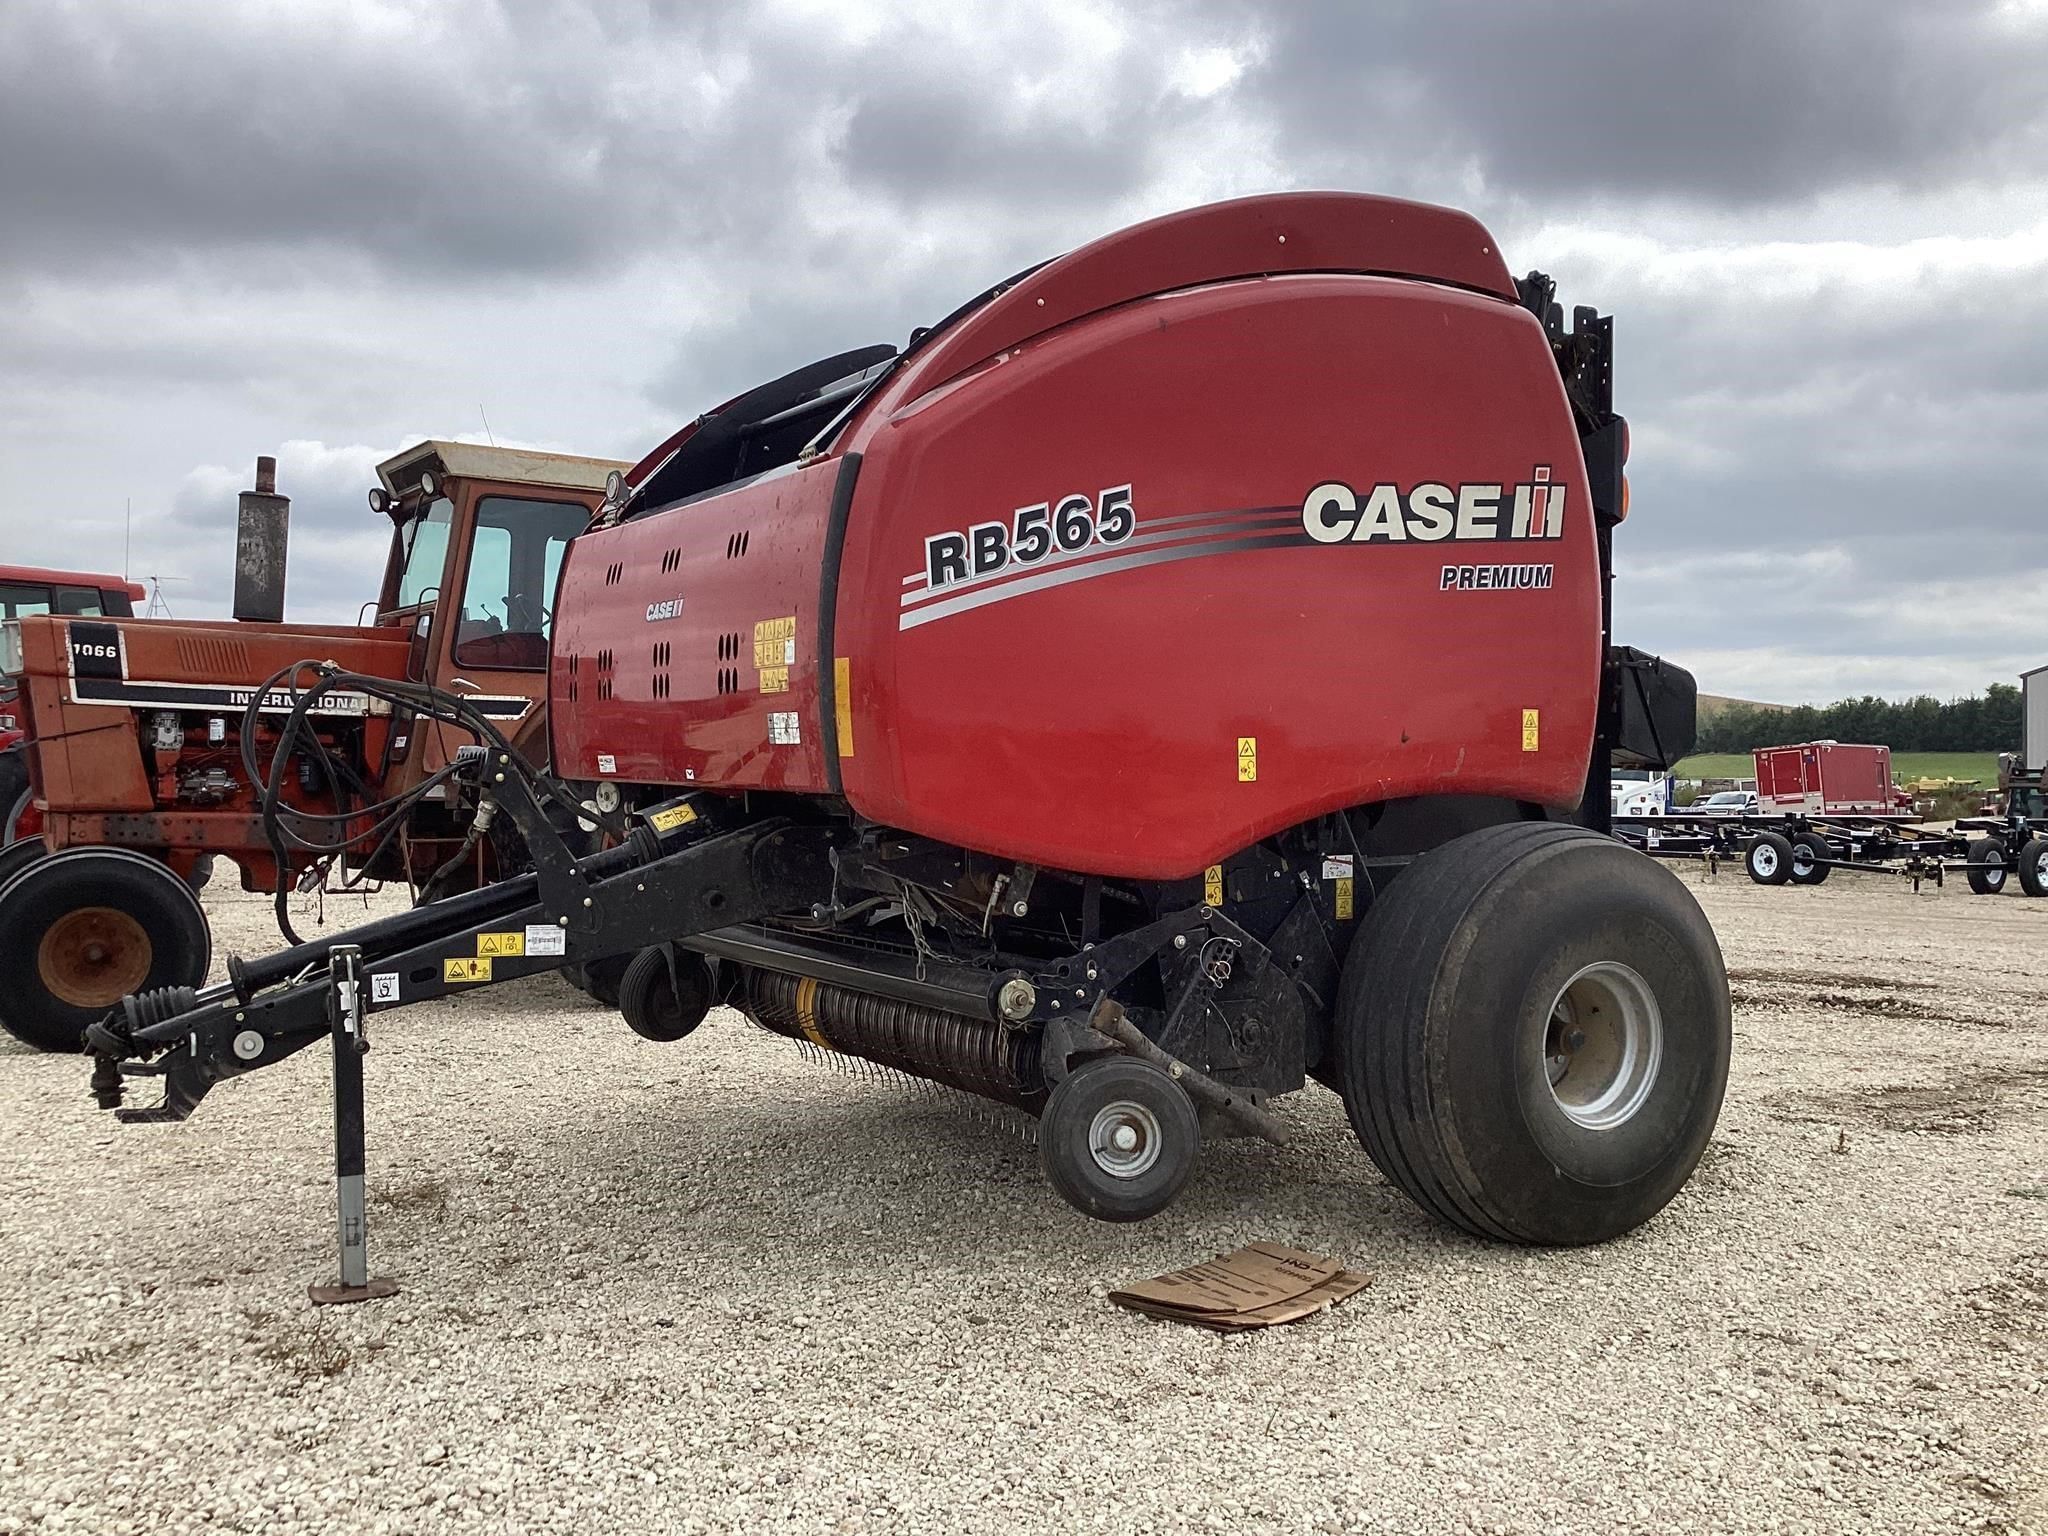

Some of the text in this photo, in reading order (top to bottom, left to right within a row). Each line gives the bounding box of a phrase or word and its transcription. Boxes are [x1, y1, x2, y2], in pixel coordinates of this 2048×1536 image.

[1302, 483, 1502, 543] CASE
[924, 483, 1136, 591] RB565
[1439, 564, 1554, 591] PREMIUM
[646, 600, 674, 622] CASE
[73, 643, 117, 658] 1066
[230, 692, 367, 710] INERNIONAL
